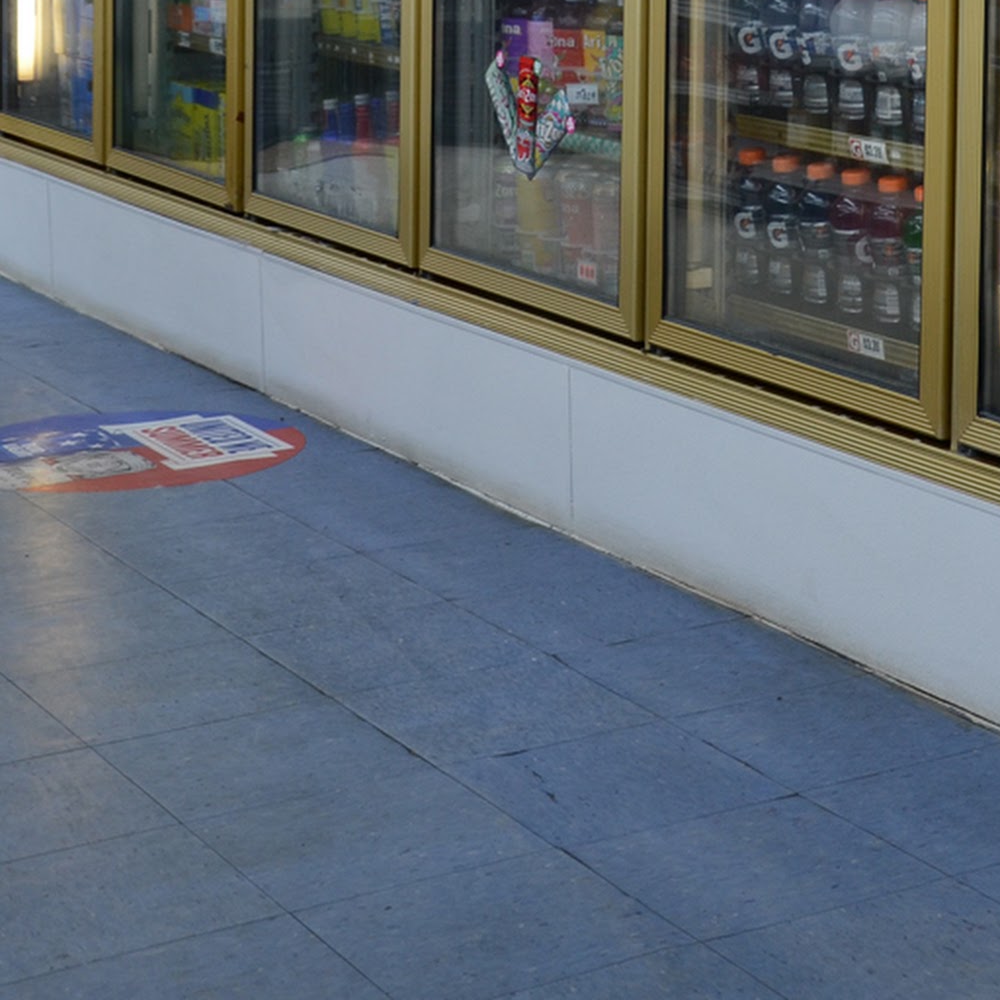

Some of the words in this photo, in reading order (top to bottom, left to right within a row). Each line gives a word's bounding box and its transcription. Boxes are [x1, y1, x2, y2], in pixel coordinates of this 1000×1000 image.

[738, 26, 763, 54] G
[769, 31, 793, 60] G
[838, 43, 863, 71] G
[735, 212, 757, 239] G
[767, 221, 789, 248] G
